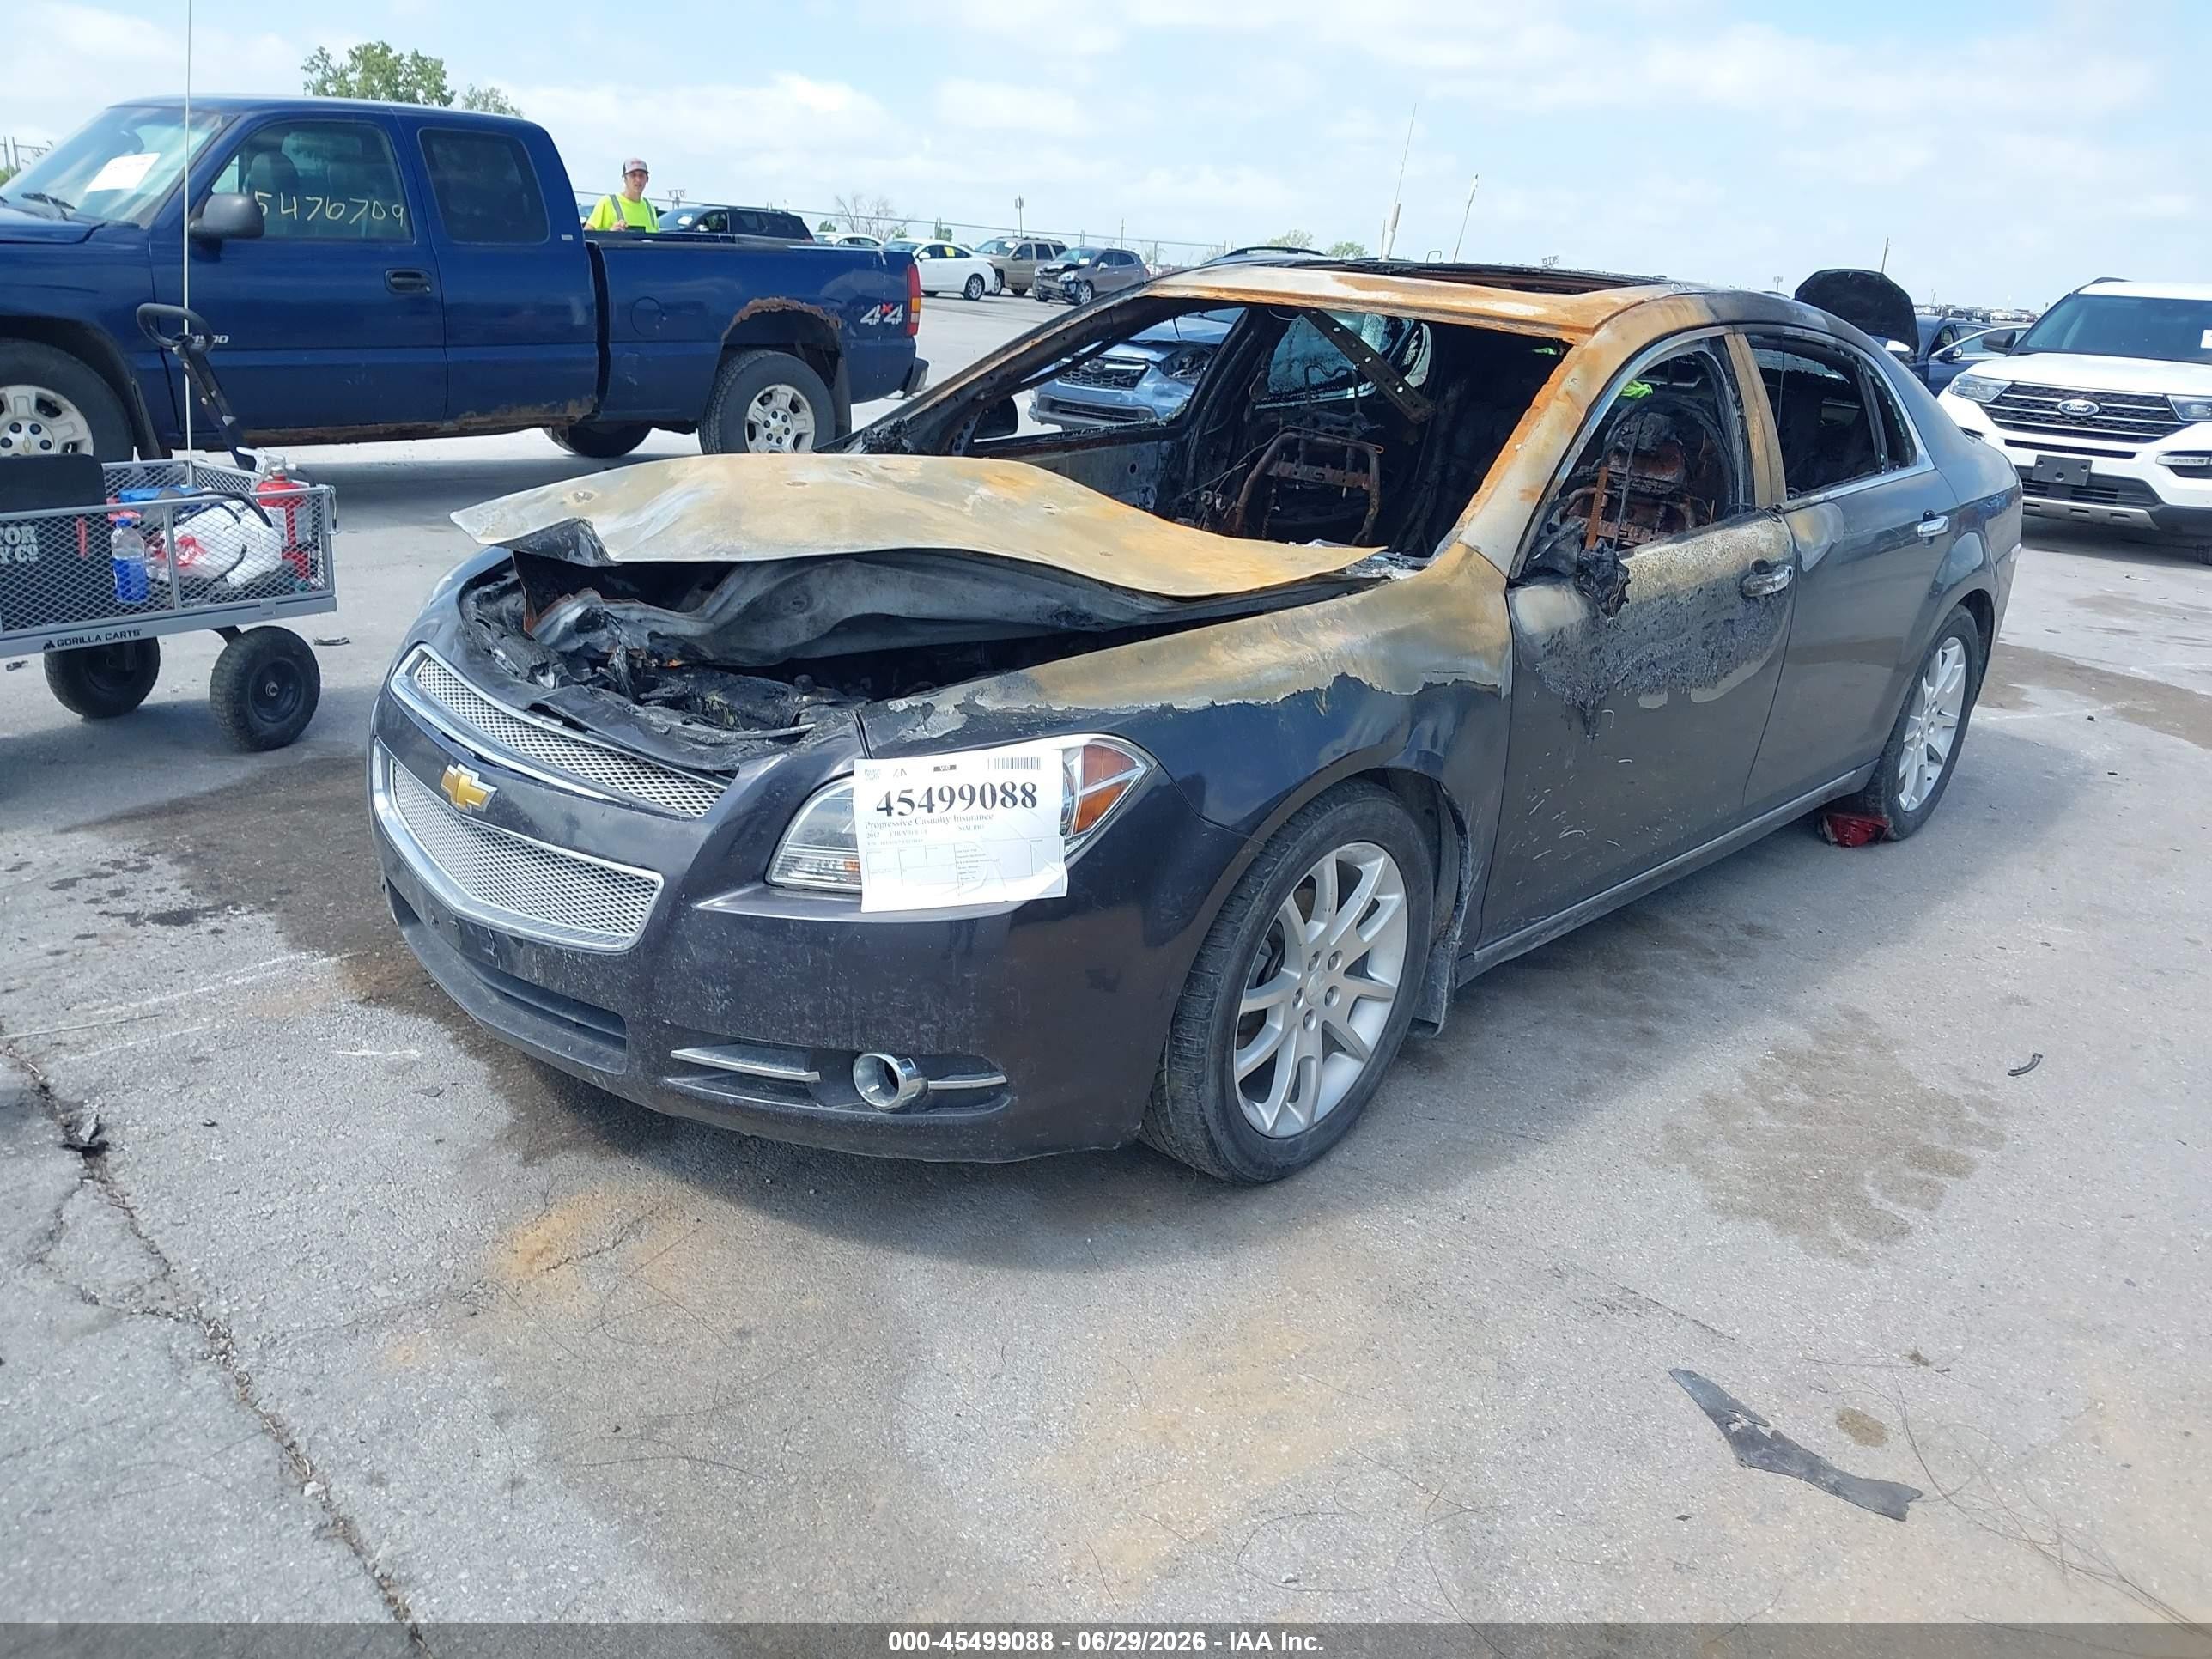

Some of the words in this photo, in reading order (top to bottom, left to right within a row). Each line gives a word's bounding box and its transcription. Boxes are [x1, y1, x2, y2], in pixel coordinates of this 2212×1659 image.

[254, 190, 404, 228] 5476709
[57, 634, 102, 647] GORILLA
[105, 629, 141, 641] CARTS
[876, 781, 1037, 817] 45499088
[865, 819, 913, 830] Progressive
[915, 815, 951, 825] Casualty
[953, 813, 994, 823] Insurance
